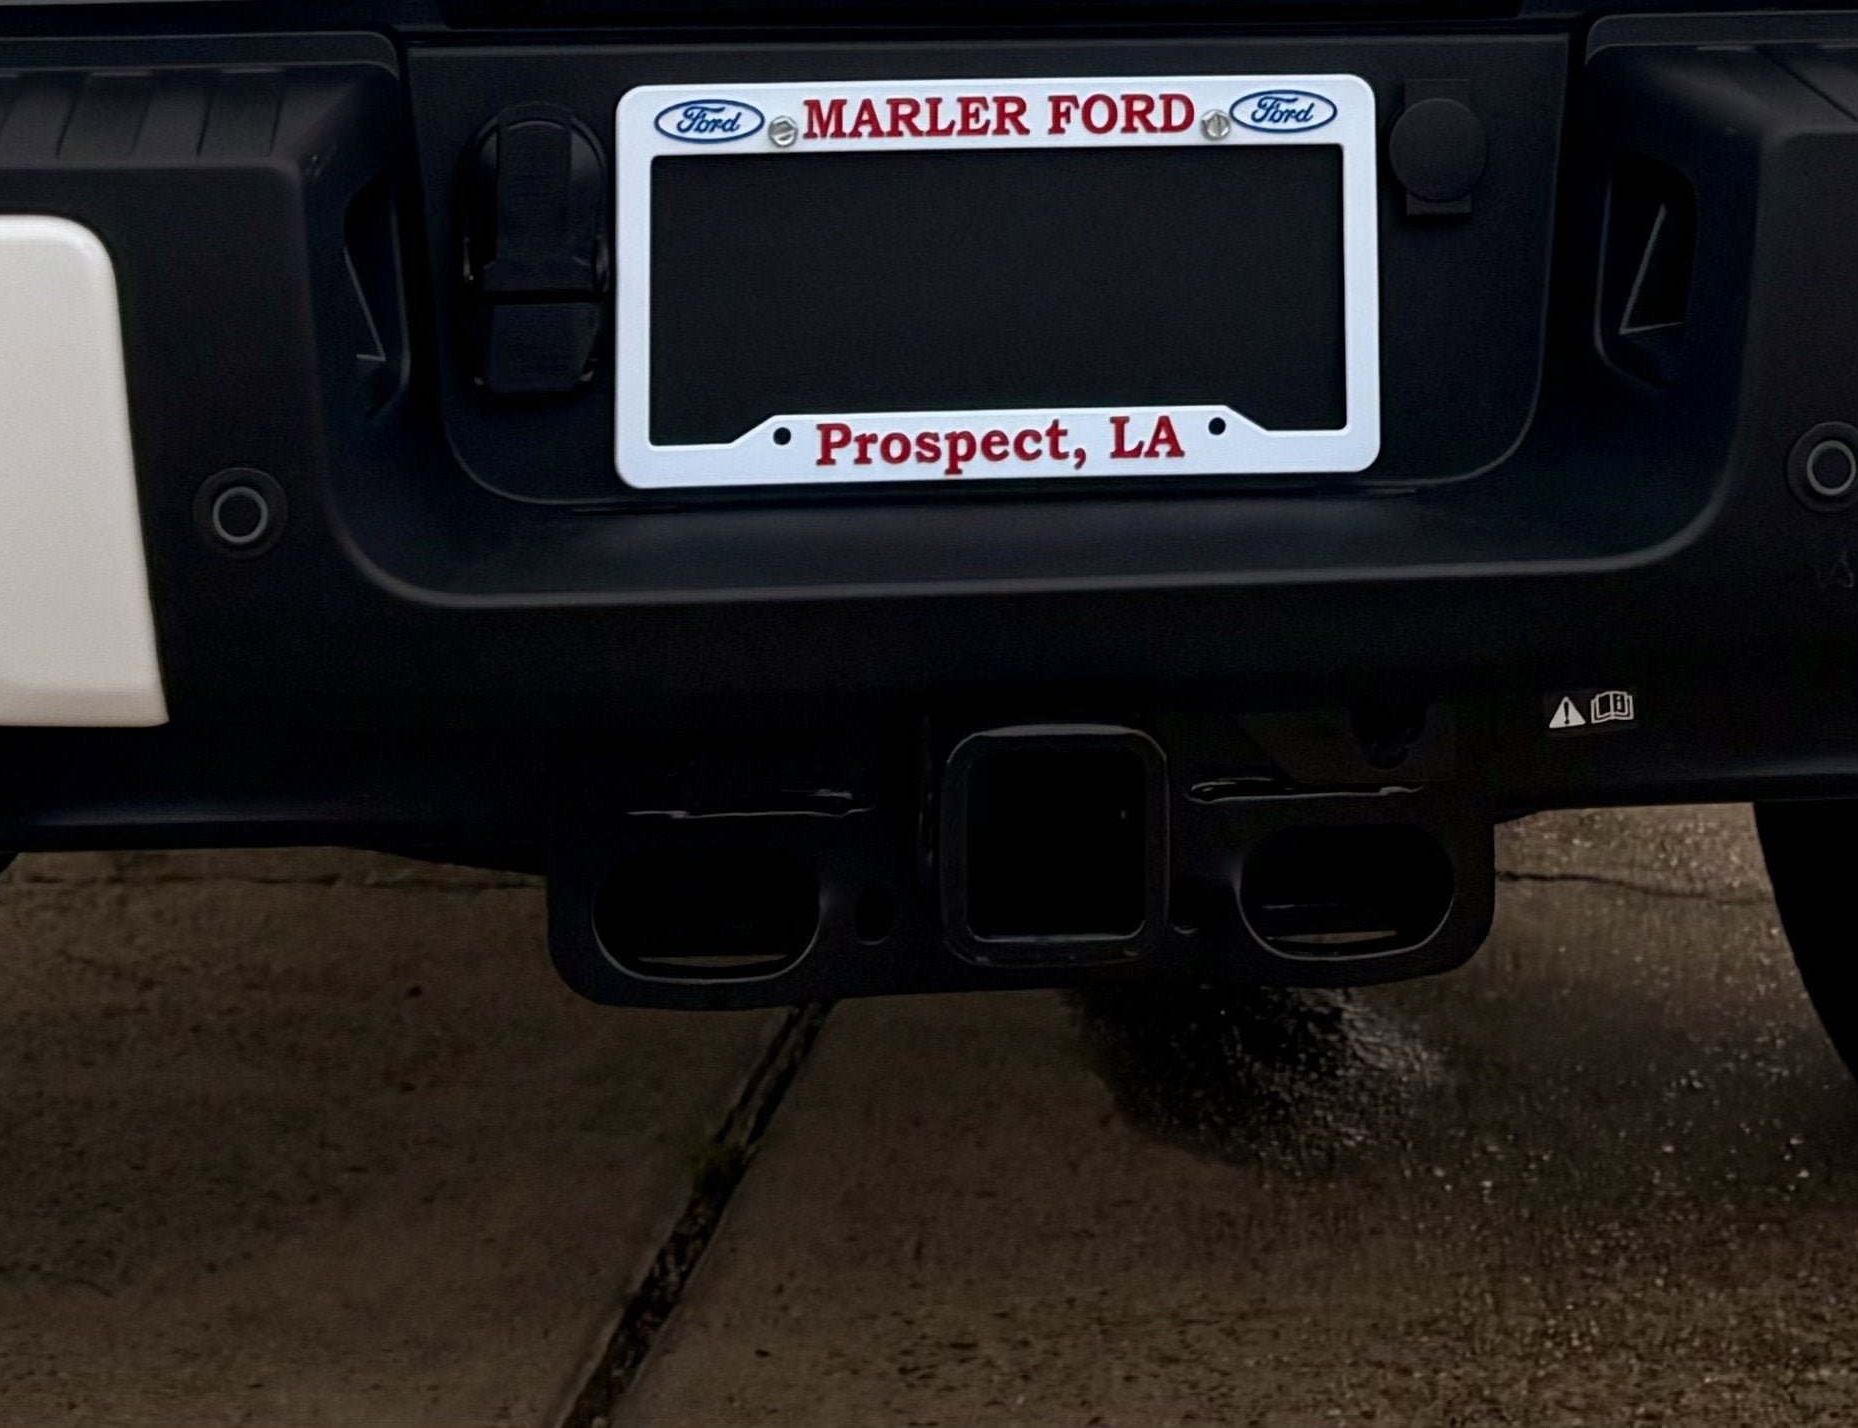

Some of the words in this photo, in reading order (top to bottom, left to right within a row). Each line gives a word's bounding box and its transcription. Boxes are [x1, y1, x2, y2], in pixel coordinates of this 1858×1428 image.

[676, 105, 743, 134] Ford
[802, 95, 1031, 140] MARLER
[1047, 93, 1196, 136] FORD
[1250, 95, 1316, 124] Ford
[815, 417, 1087, 476] Prospect,
[1108, 414, 1186, 460] LA
